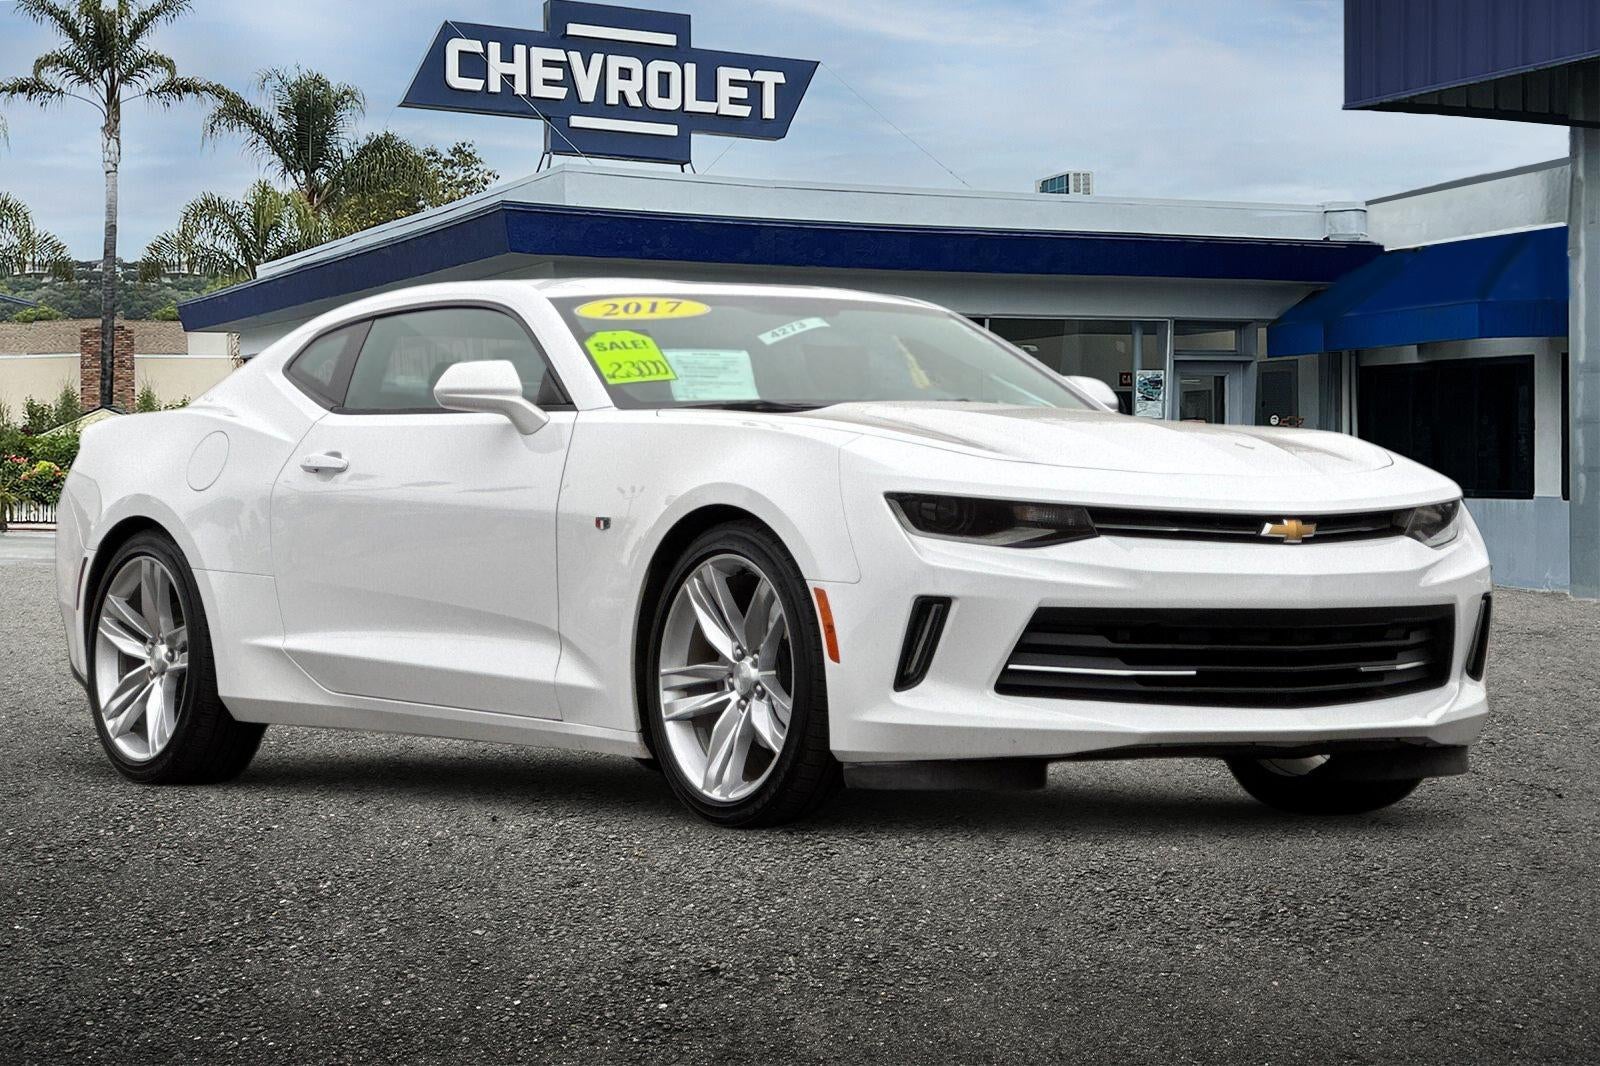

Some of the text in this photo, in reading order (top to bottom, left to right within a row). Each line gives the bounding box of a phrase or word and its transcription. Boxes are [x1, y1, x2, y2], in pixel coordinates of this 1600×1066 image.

[445, 37, 786, 119] CHEVROLET
[602, 301, 683, 317] 2017
[594, 339, 649, 352] SALE!
